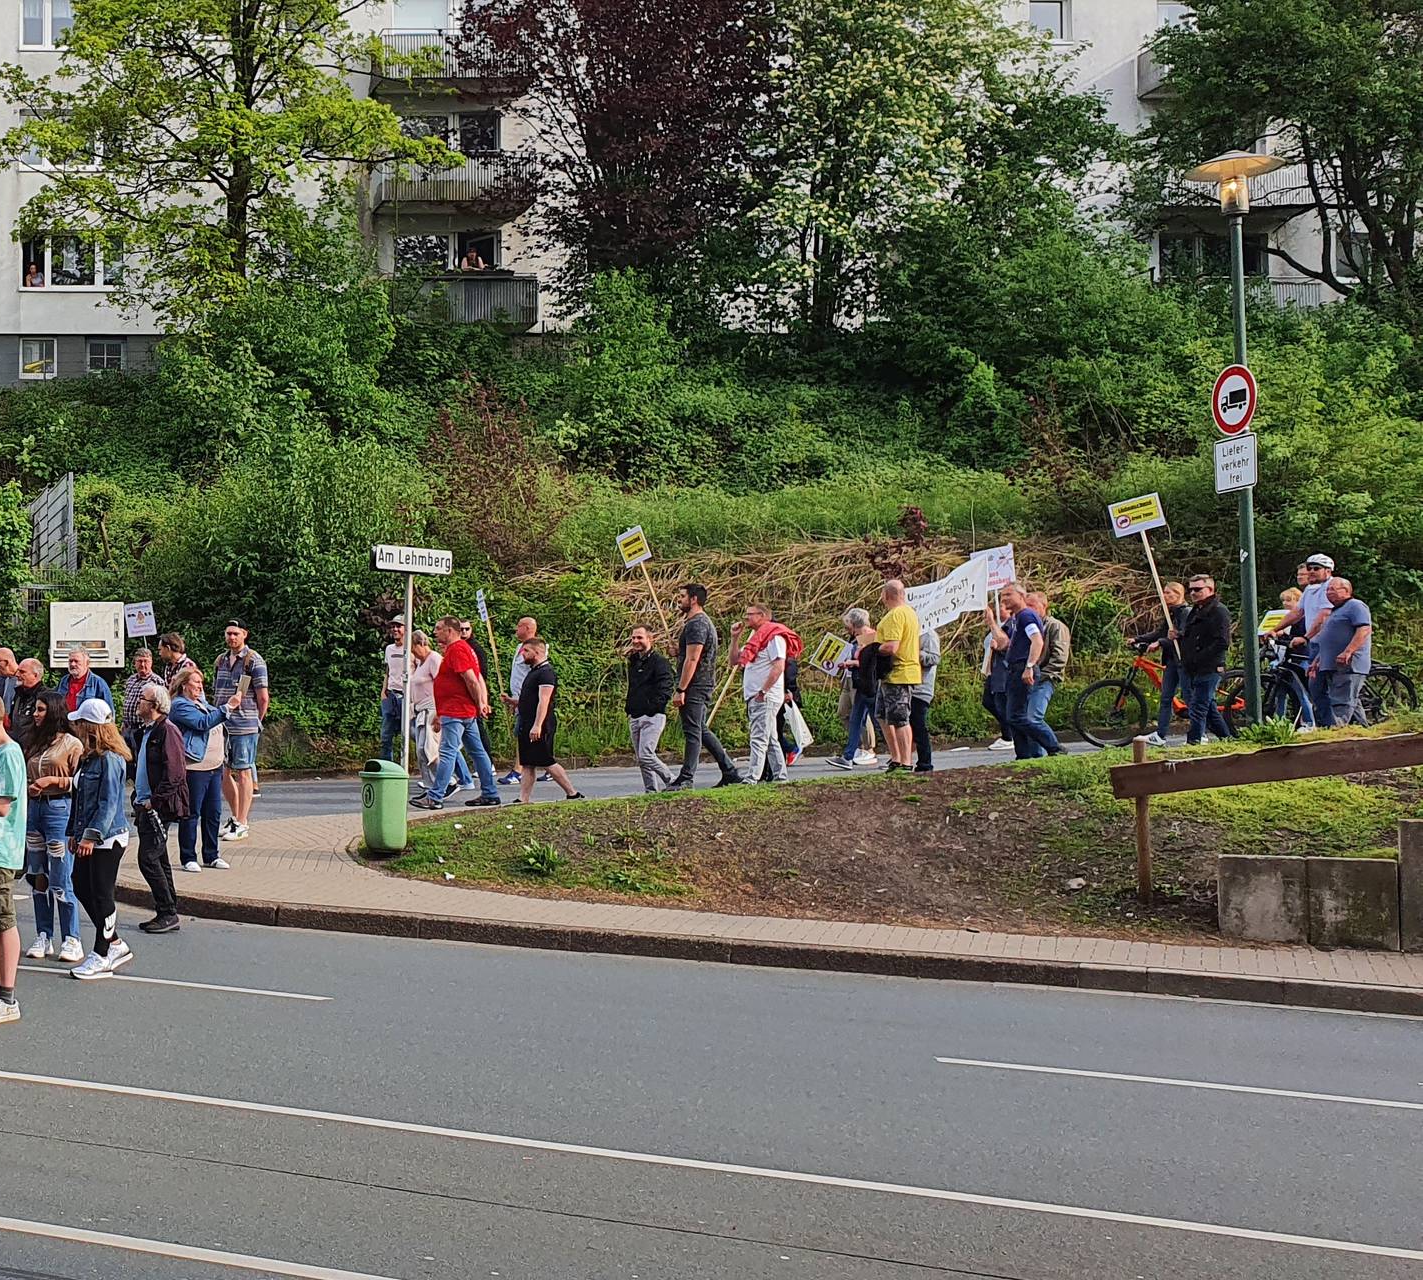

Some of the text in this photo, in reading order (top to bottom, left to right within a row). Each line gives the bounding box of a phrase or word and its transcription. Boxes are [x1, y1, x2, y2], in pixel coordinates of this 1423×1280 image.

[1222, 444, 1248, 458] Liefer-
[1221, 457, 1249, 471] verkehr
[1229, 471, 1243, 484] frei
[378, 547, 451, 573] Am Lehmberg
